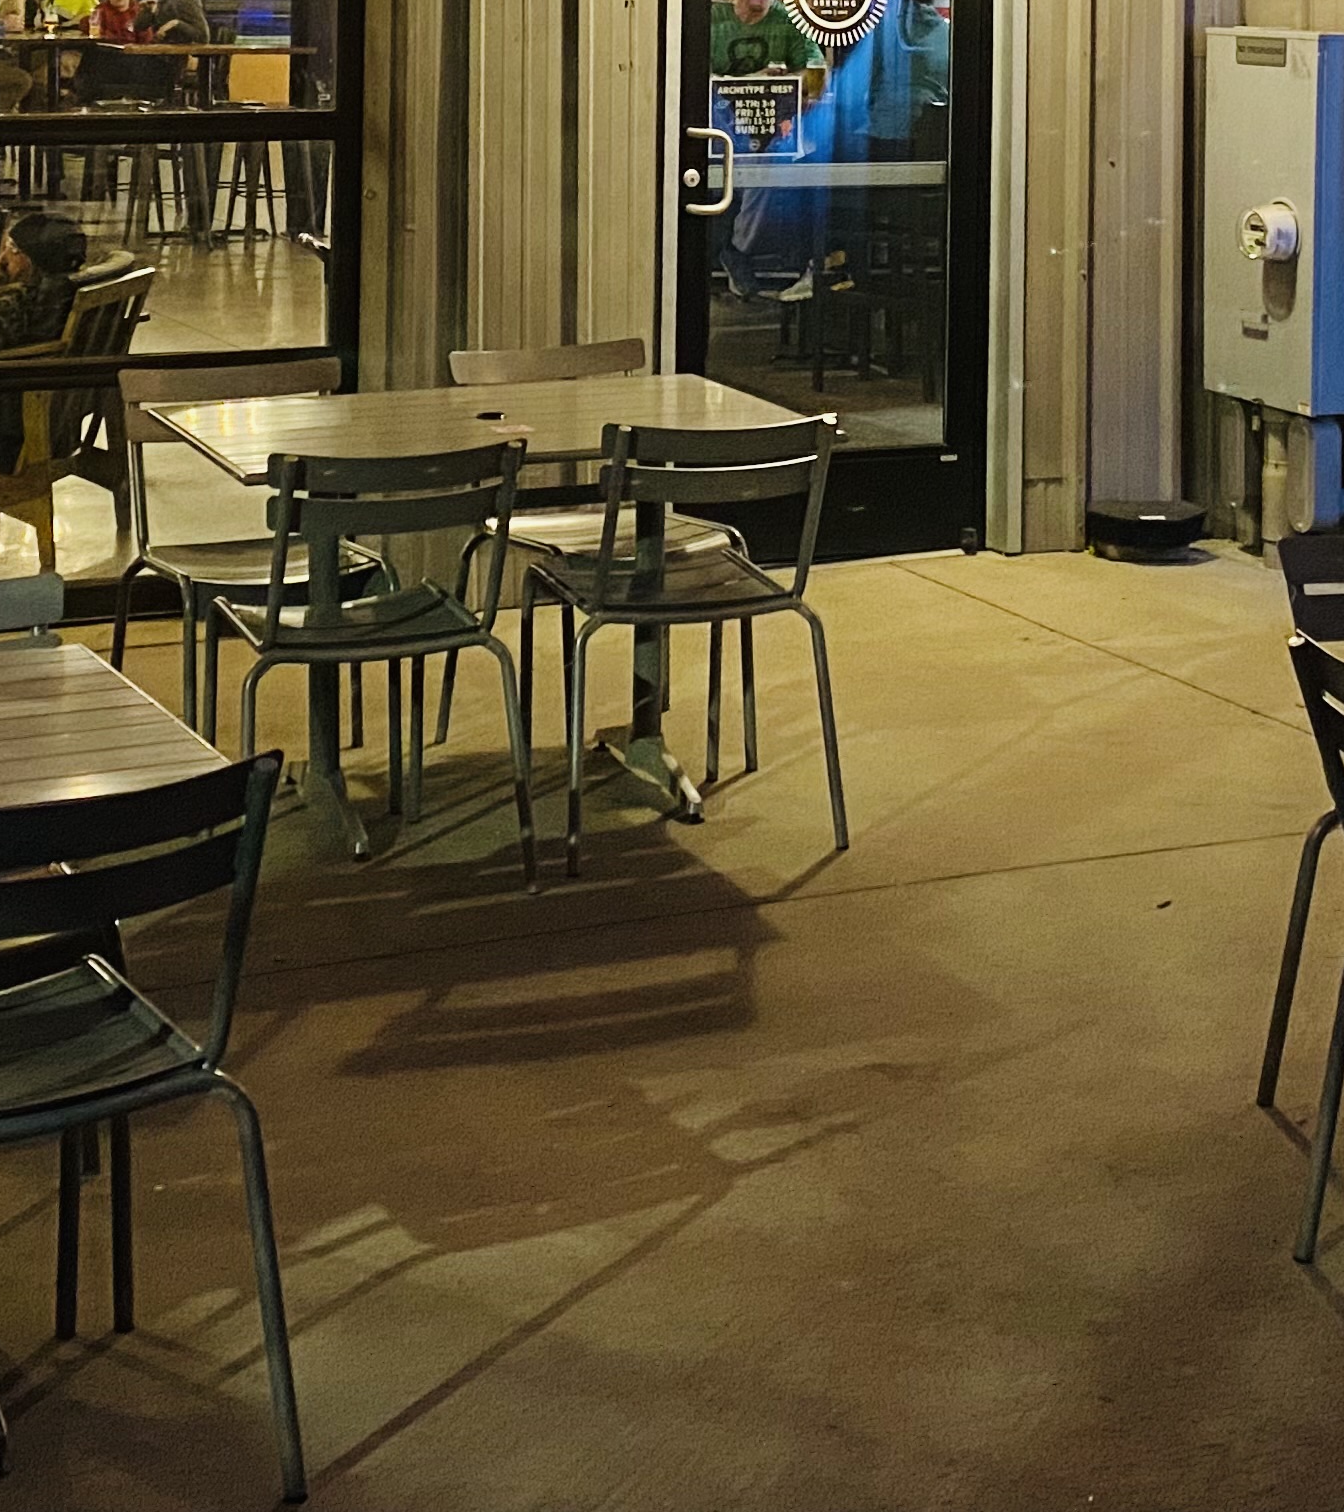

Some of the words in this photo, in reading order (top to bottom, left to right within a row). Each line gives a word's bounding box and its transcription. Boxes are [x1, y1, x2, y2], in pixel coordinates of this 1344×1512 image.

[813, 0, 857, 8] BREWING
[717, 85, 765, 95] ARCHETYPE
[770, 84, 794, 94] WEST
[735, 108, 754, 117] FRI:
[755, 108, 776, 117] 1-10
[735, 125, 759, 134] SUN:
